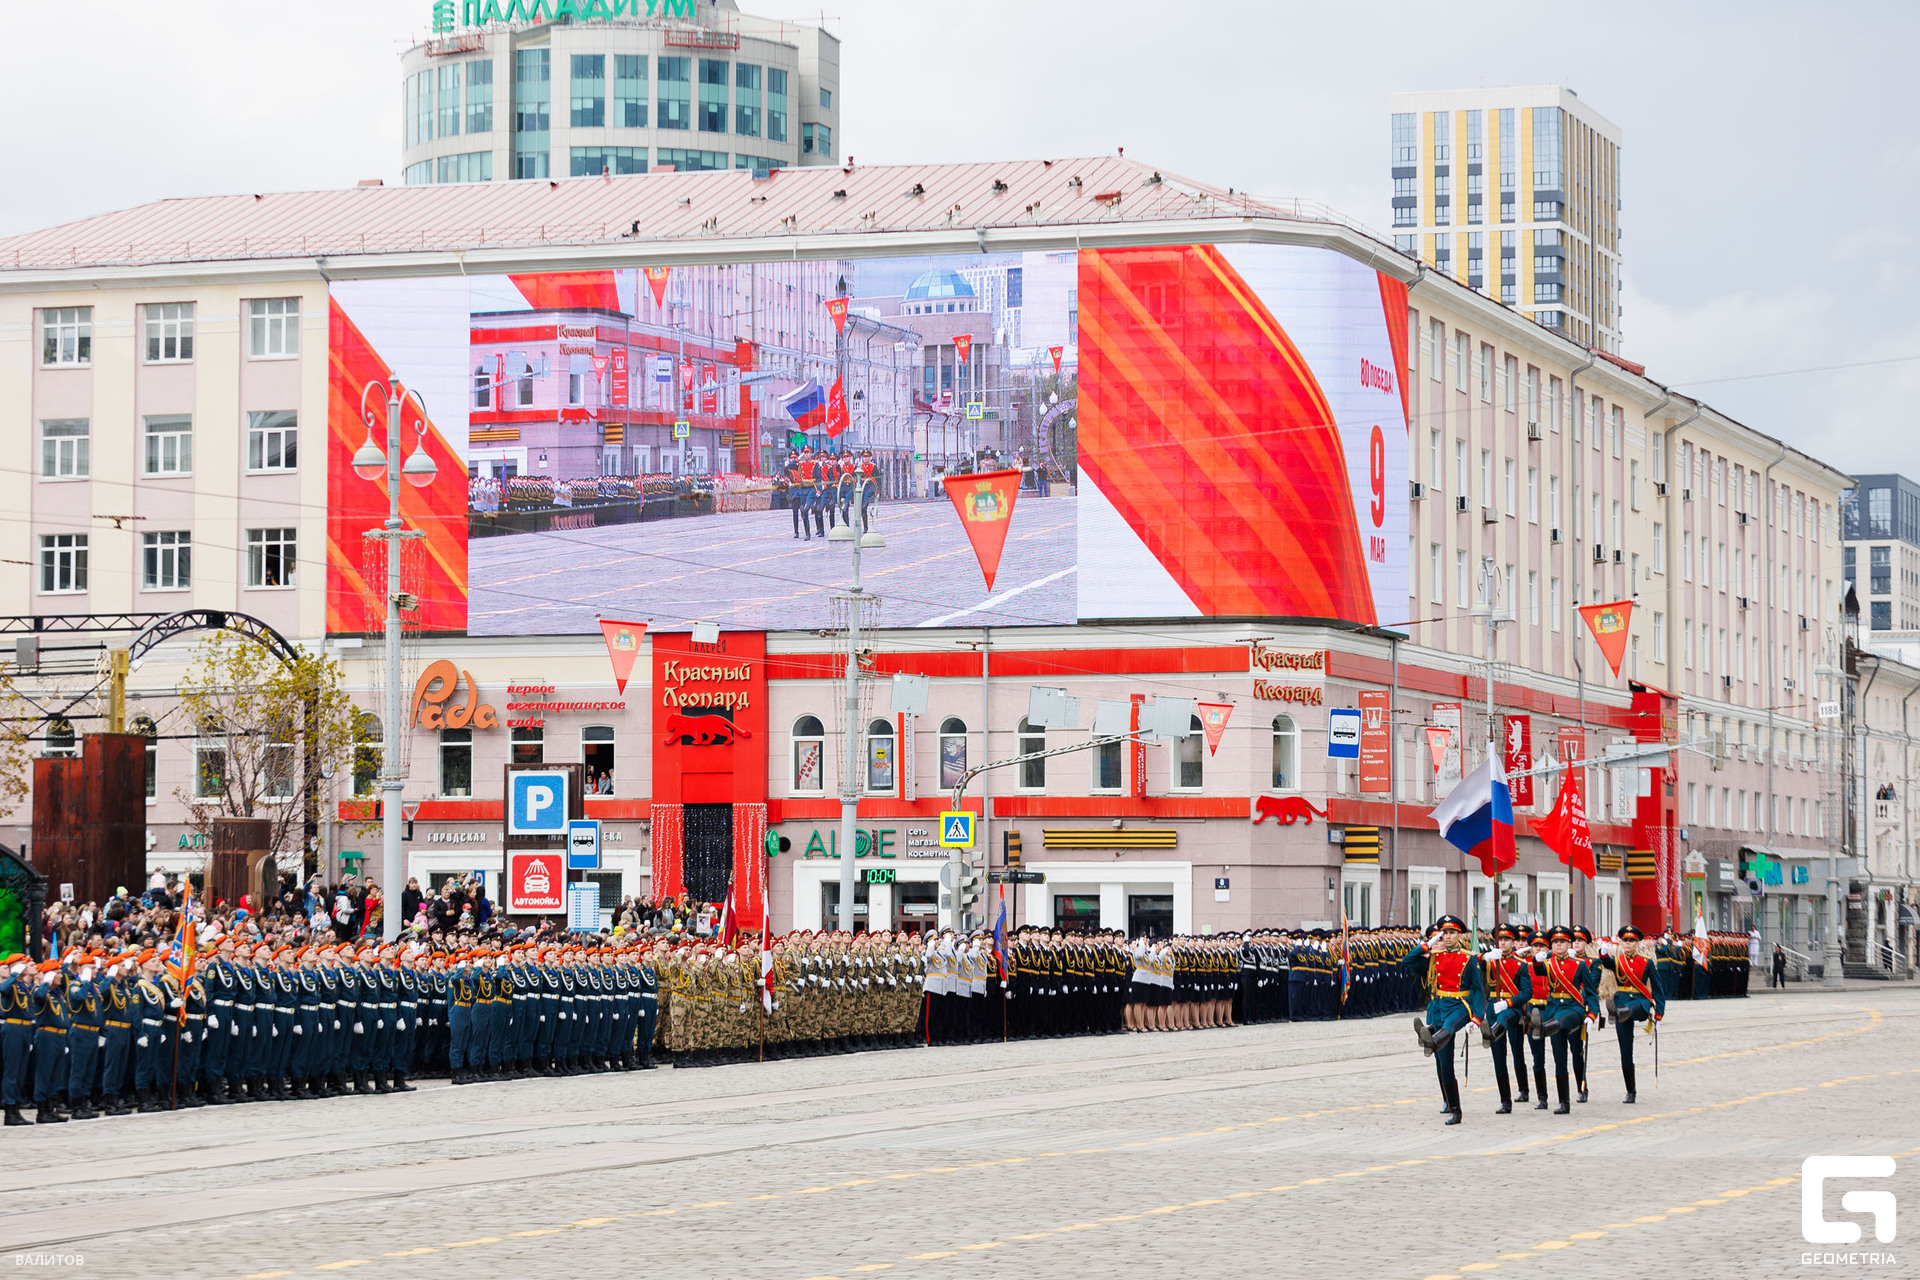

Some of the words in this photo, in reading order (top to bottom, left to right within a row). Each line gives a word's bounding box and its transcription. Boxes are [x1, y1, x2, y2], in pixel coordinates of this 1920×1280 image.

[1360, 357, 1370, 387] 80
[1370, 364, 1394, 395] ПОБЕДА!
[1370, 424, 1385, 528] 9
[1370, 535, 1386, 564] МАЯ
[1251, 646, 1324, 672] Красный
[663, 660, 751, 687] Красный
[409, 659, 500, 730] Рада
[506, 685, 556, 697] первое
[662, 686, 751, 712] Леопард
[1253, 678, 1324, 706] Леопард
[506, 701, 626, 714] вегетарианское
[1820, 704, 1839, 716] 1188
[506, 715, 545, 731] кафе
[796, 744, 819, 783] ОПТИКА
[804, 753, 820, 779] 100%
[526, 785, 554, 822] P
[427, 833, 487, 844] ГОРОДСКАЯ
[803, 829, 896, 858] ALOE
[908, 828, 928, 836] сеть
[908, 839, 940, 847] магази
[908, 850, 950, 858] косметик
[866, 869, 895, 883] 10:04
[513, 896, 560, 906] АВТОМОЙКА
